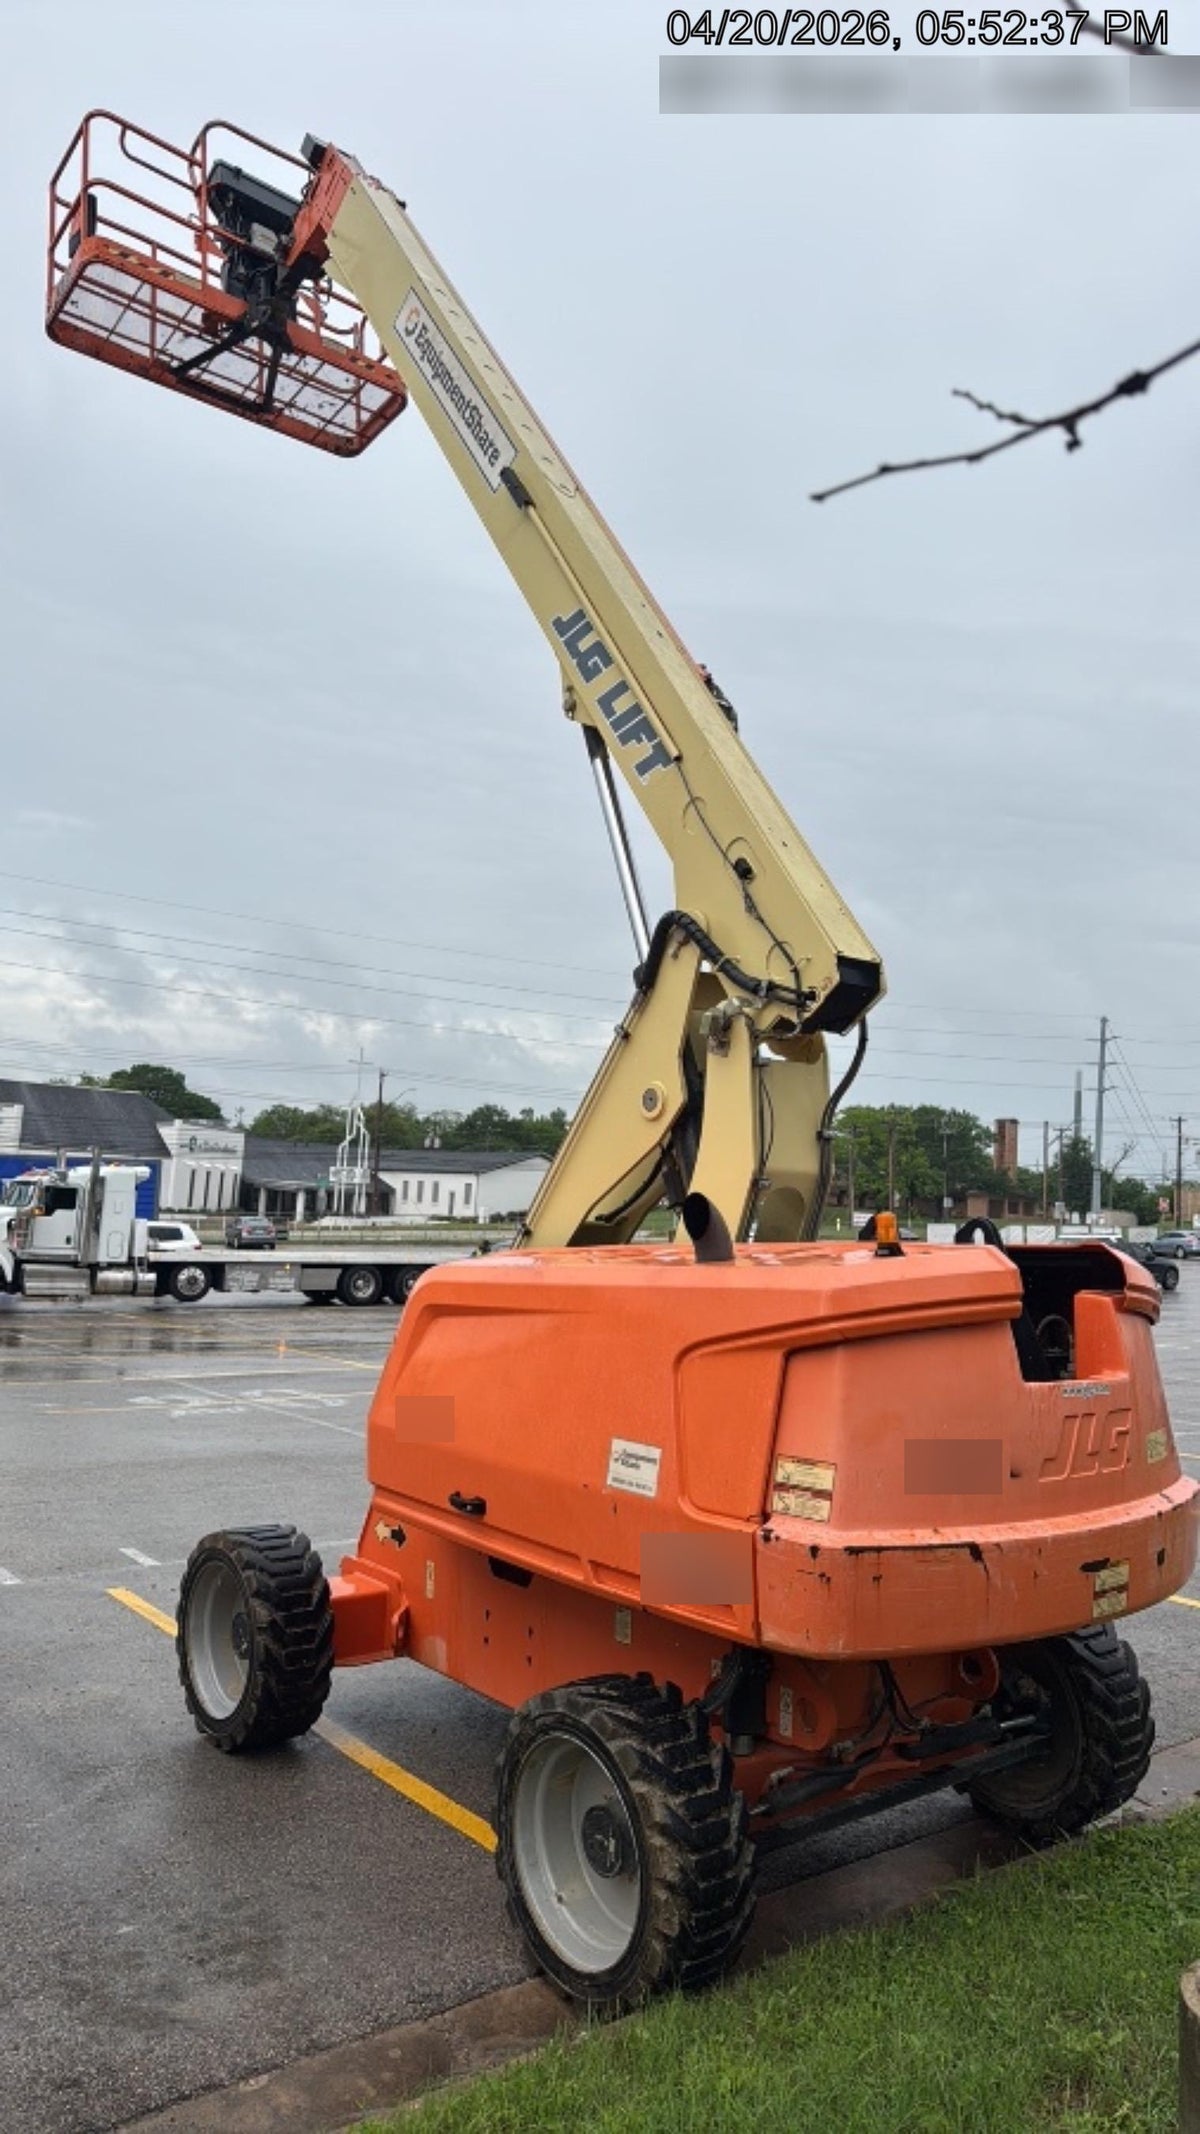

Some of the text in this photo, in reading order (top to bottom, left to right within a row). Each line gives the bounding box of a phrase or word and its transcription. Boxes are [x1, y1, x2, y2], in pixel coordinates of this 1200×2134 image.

[414, 322, 501, 468] EquipmentShare
[551, 608, 675, 787] JLG LIFT
[1039, 1408, 1132, 1482] JLG
